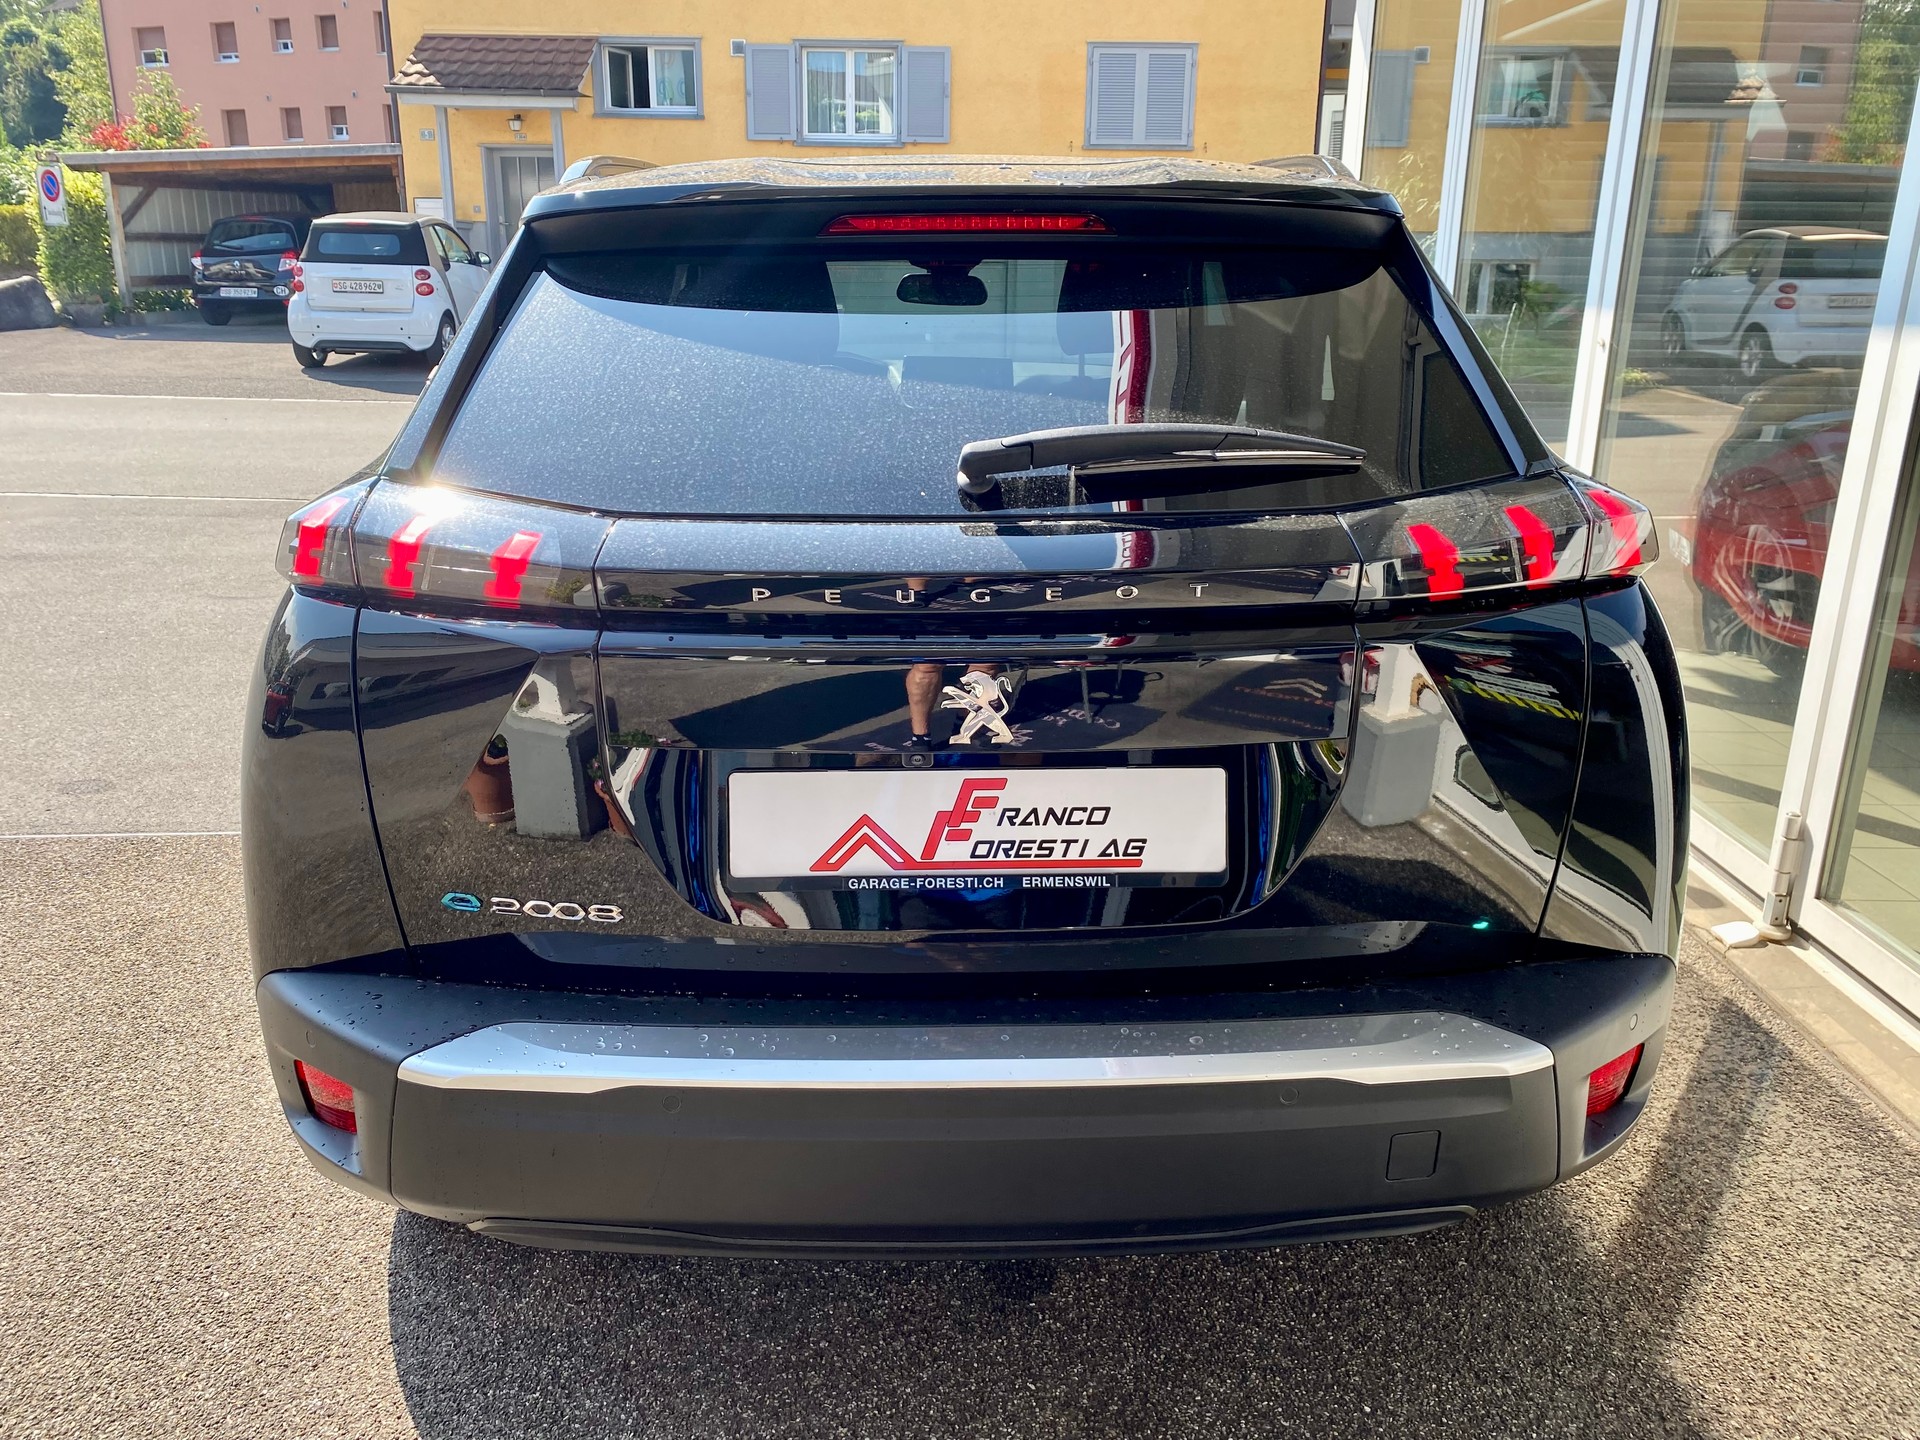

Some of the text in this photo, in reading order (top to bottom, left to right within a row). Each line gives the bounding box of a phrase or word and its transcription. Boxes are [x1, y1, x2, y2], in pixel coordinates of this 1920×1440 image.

[275, 286, 287, 295] CH
[338, 281, 377, 291] SG 428962
[752, 582, 1213, 604] PEUGEOT
[1097, 838, 1148, 858] AG
[848, 875, 1111, 890] GARAGE-FORESTI.CH ERMENSWIL
